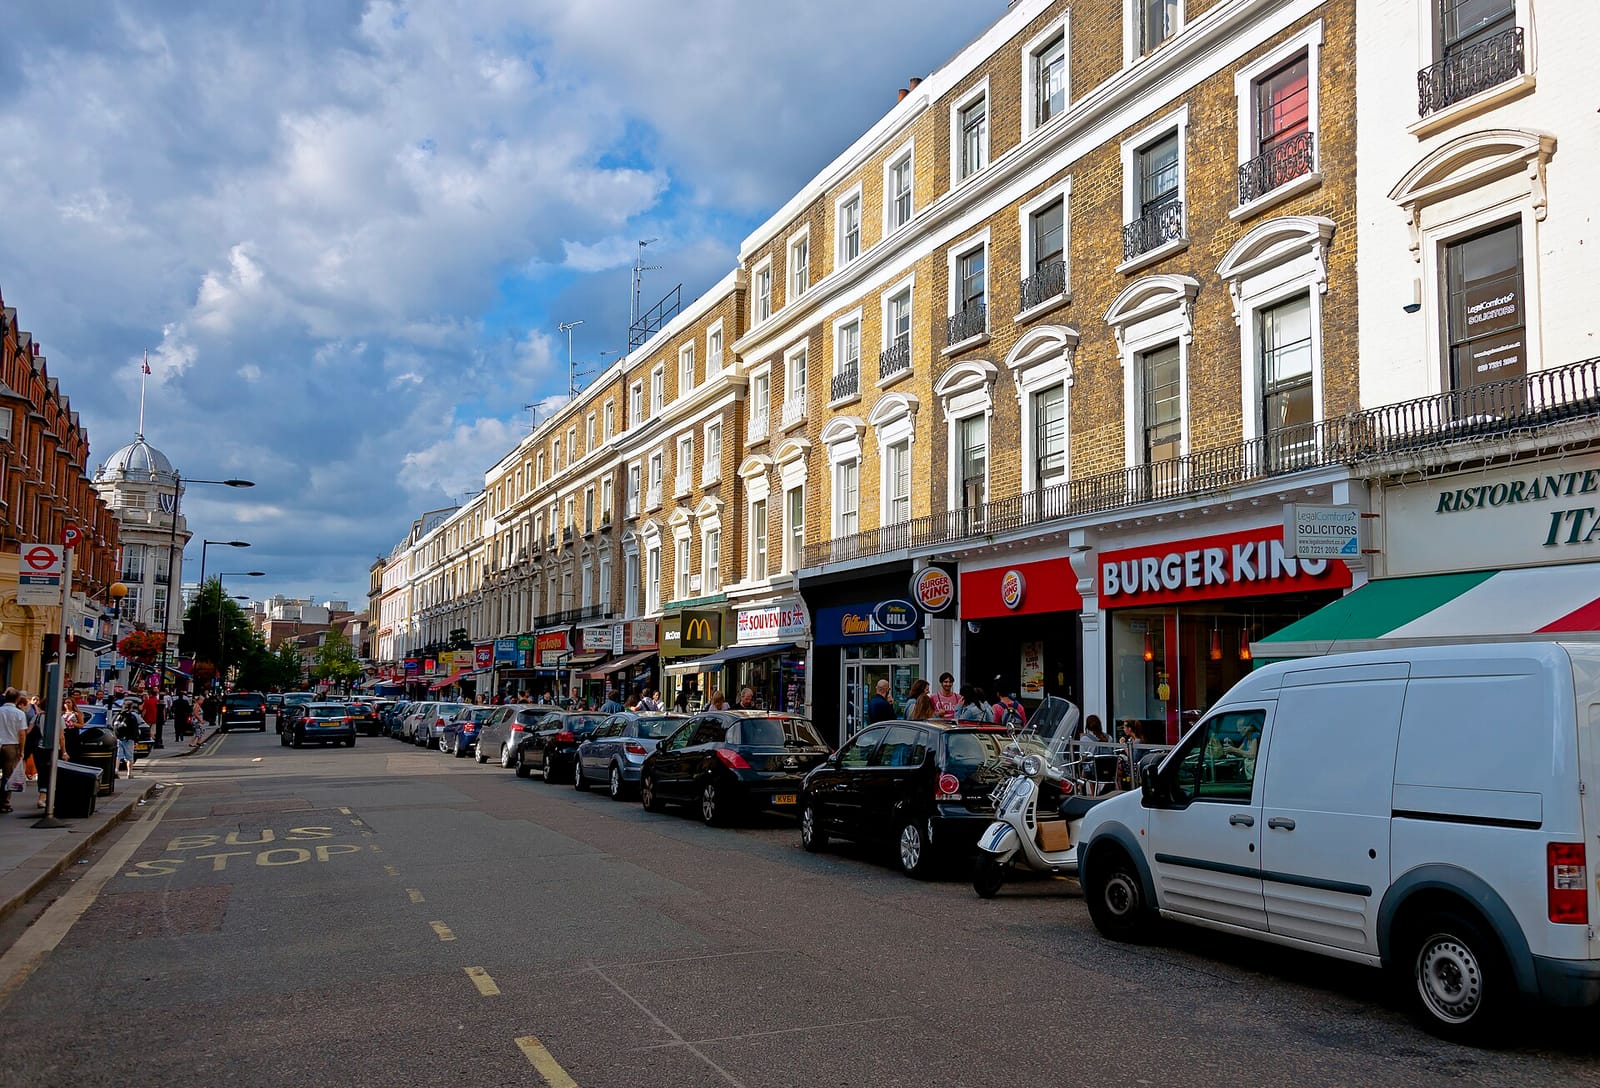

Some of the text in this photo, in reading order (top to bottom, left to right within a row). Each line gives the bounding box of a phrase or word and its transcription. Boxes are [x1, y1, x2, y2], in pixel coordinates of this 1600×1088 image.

[1435, 469, 1600, 513] RISTORANTE
[1297, 511, 1347, 522] LegalComfort
[1298, 524, 1357, 535] SOLICITORS
[1298, 545, 1310, 554] 020
[1311, 545, 1324, 554] 7221
[1325, 546, 1339, 554] 2005
[1103, 547, 1226, 596] BURGER
[920, 576, 949, 591] BURGER
[1004, 584, 1018, 597] KING
[920, 584, 950, 602] KING
[748, 610, 792, 631] SOUVENIRS
[886, 613, 908, 625] HILL
[166, 826, 334, 851] BUS
[125, 844, 361, 878] STOP
